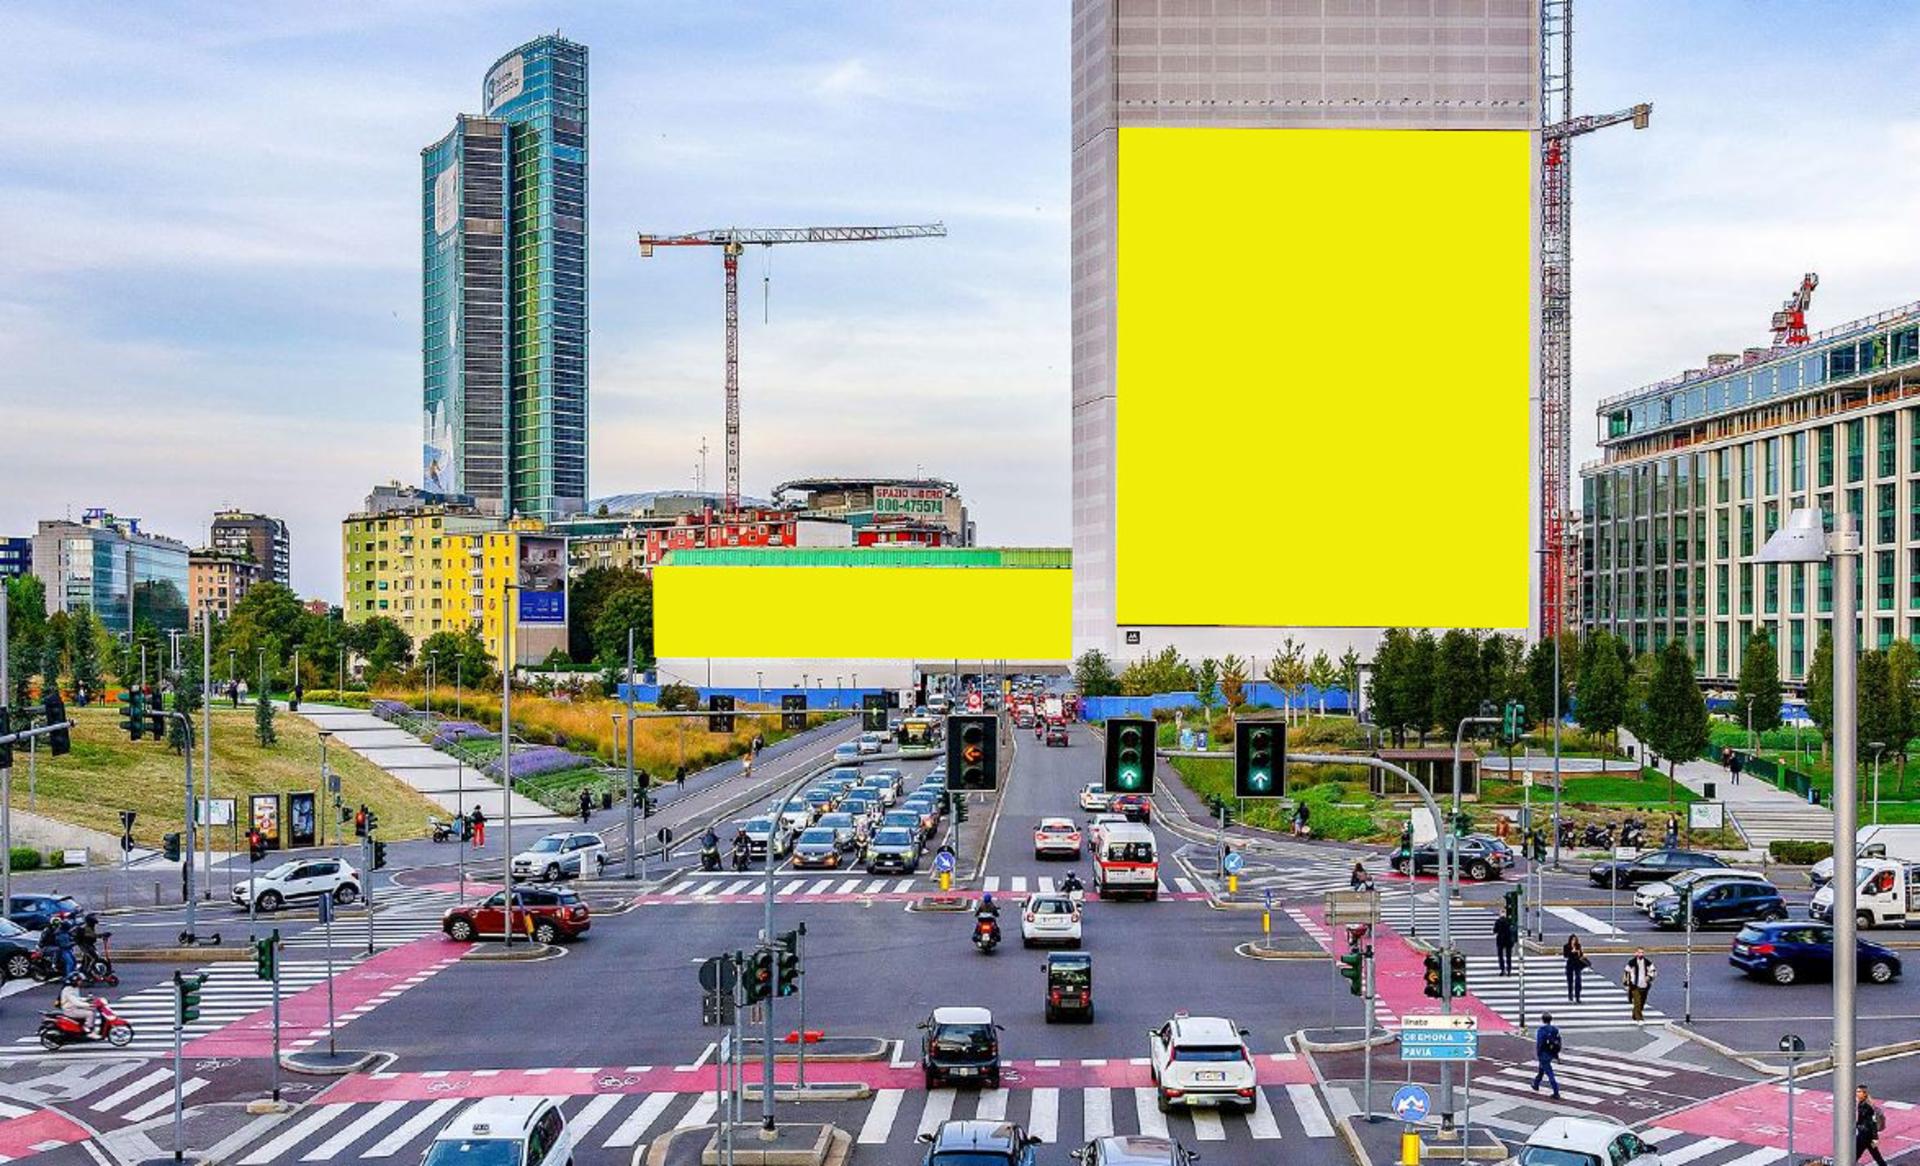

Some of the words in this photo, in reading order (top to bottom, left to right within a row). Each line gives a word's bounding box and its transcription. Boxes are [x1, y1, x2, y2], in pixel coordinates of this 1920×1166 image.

[729, 441, 737, 481] COMA
[876, 488, 909, 498] SPAZIO
[876, 499, 943, 513] 800-475574
[1402, 1032, 1454, 1041] CREMONA
[1403, 1047, 1432, 1056] PAVIA
